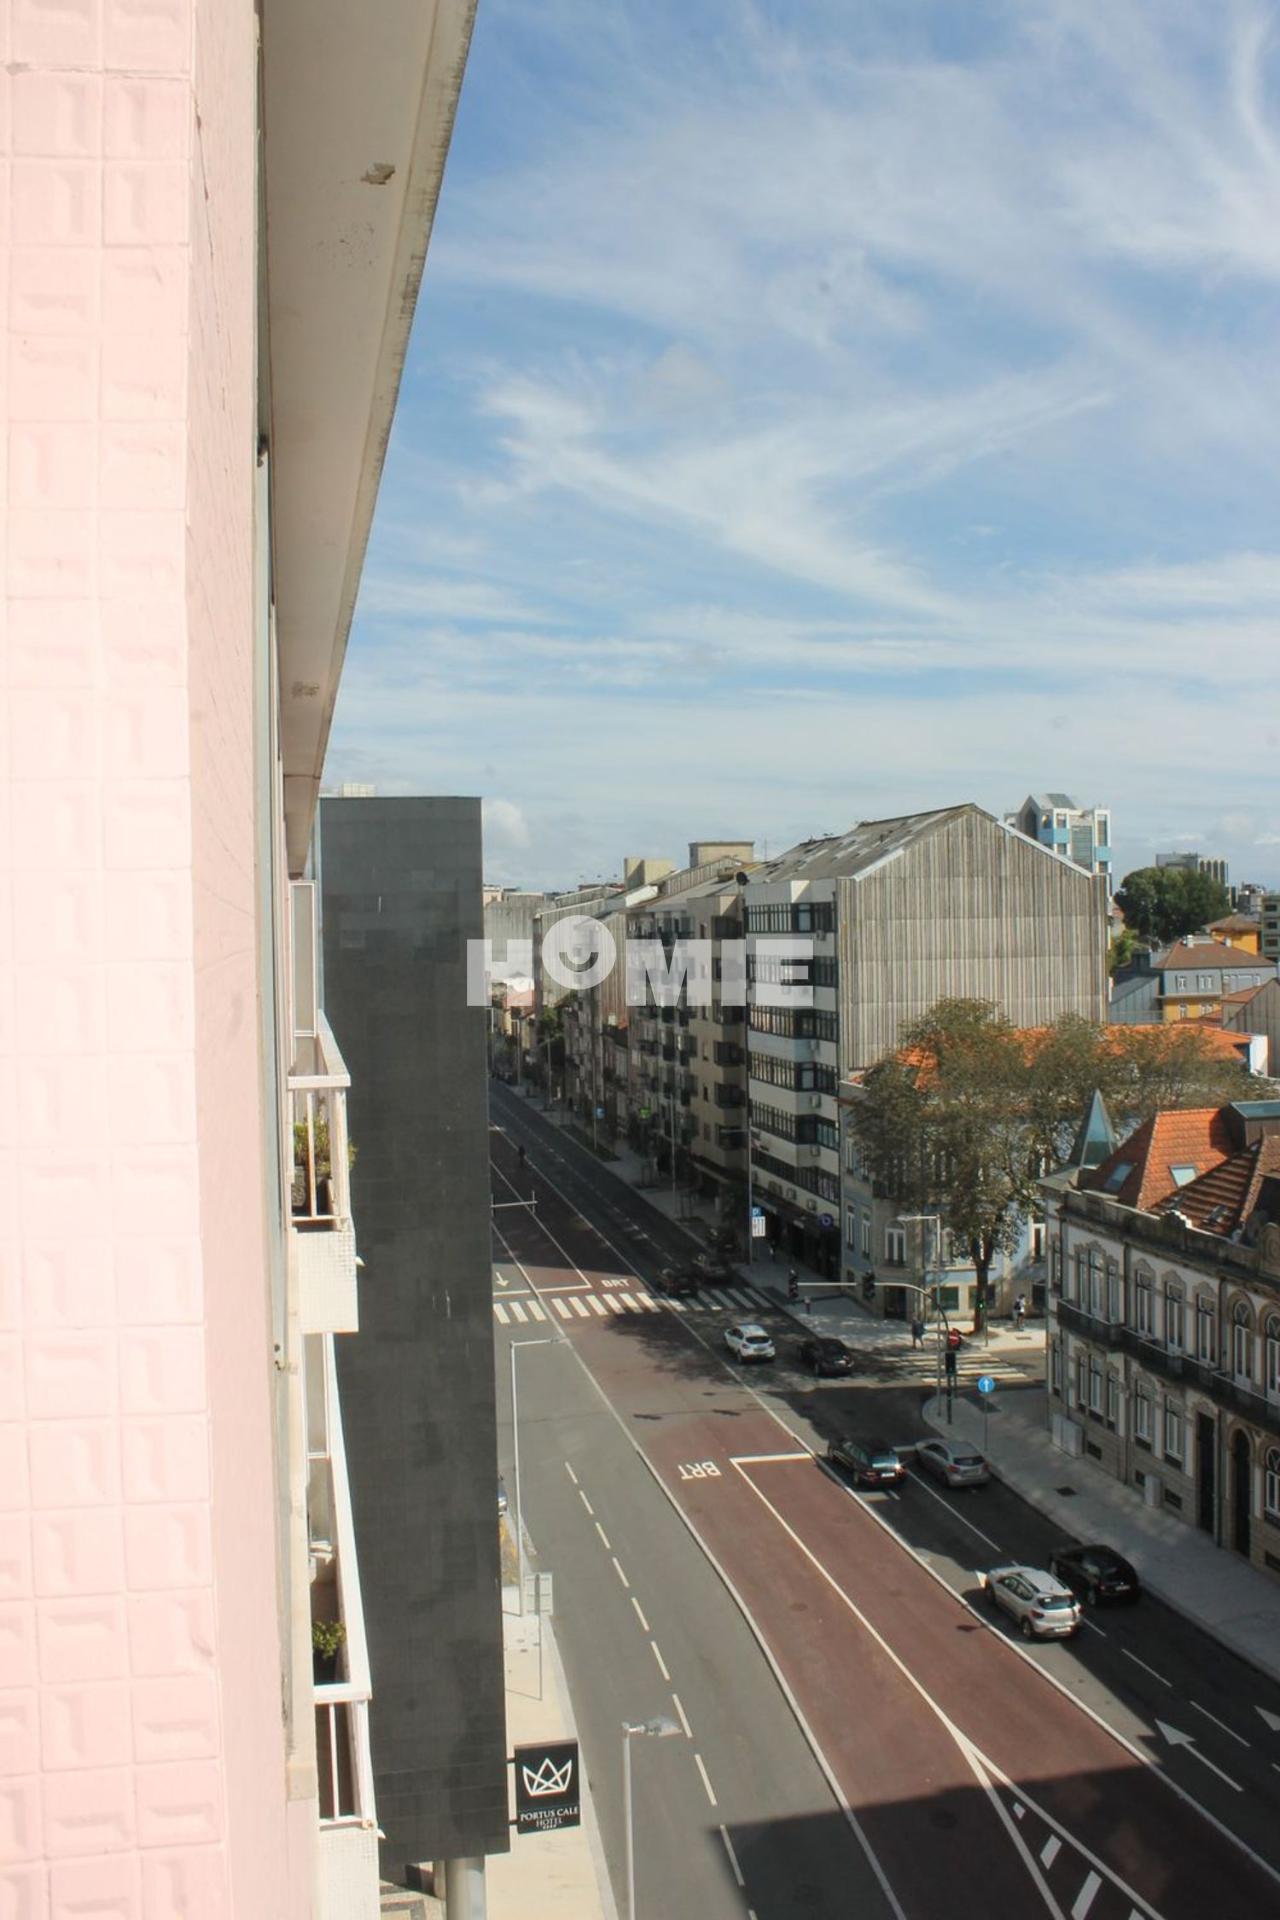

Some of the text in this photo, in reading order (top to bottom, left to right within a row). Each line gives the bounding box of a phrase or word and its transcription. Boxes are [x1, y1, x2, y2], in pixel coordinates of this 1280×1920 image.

[678, 1461, 722, 1480] BRT
[520, 1809, 555, 1822] PORTUS
[536, 1817, 562, 1827] HOTEL
